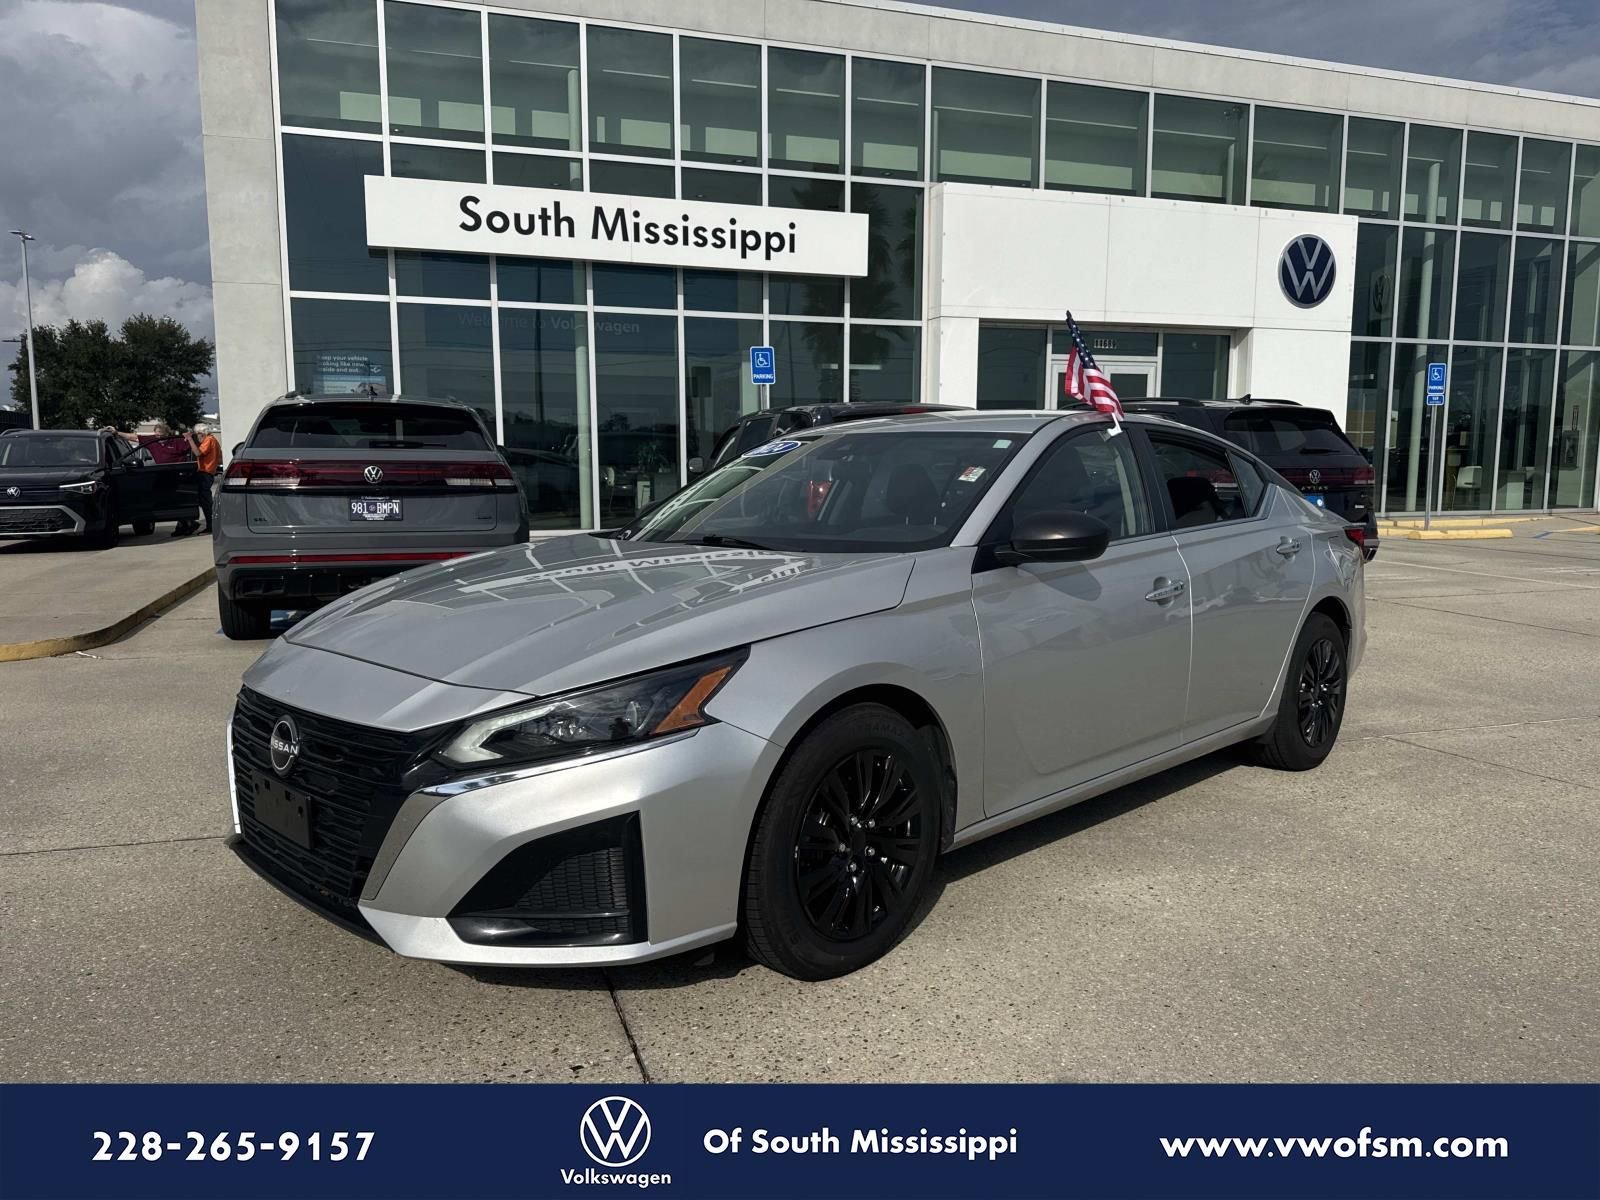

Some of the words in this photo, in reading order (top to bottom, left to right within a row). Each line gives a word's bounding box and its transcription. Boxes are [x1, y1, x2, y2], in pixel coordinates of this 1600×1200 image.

[459, 194, 575, 238] South
[591, 205, 797, 260] Mississippi
[457, 312, 527, 329] Welme
[550, 313, 640, 335] Volwagen
[351, 502, 369, 514] 981
[376, 502, 400, 514] BMPN
[271, 737, 299, 755] SSAN
